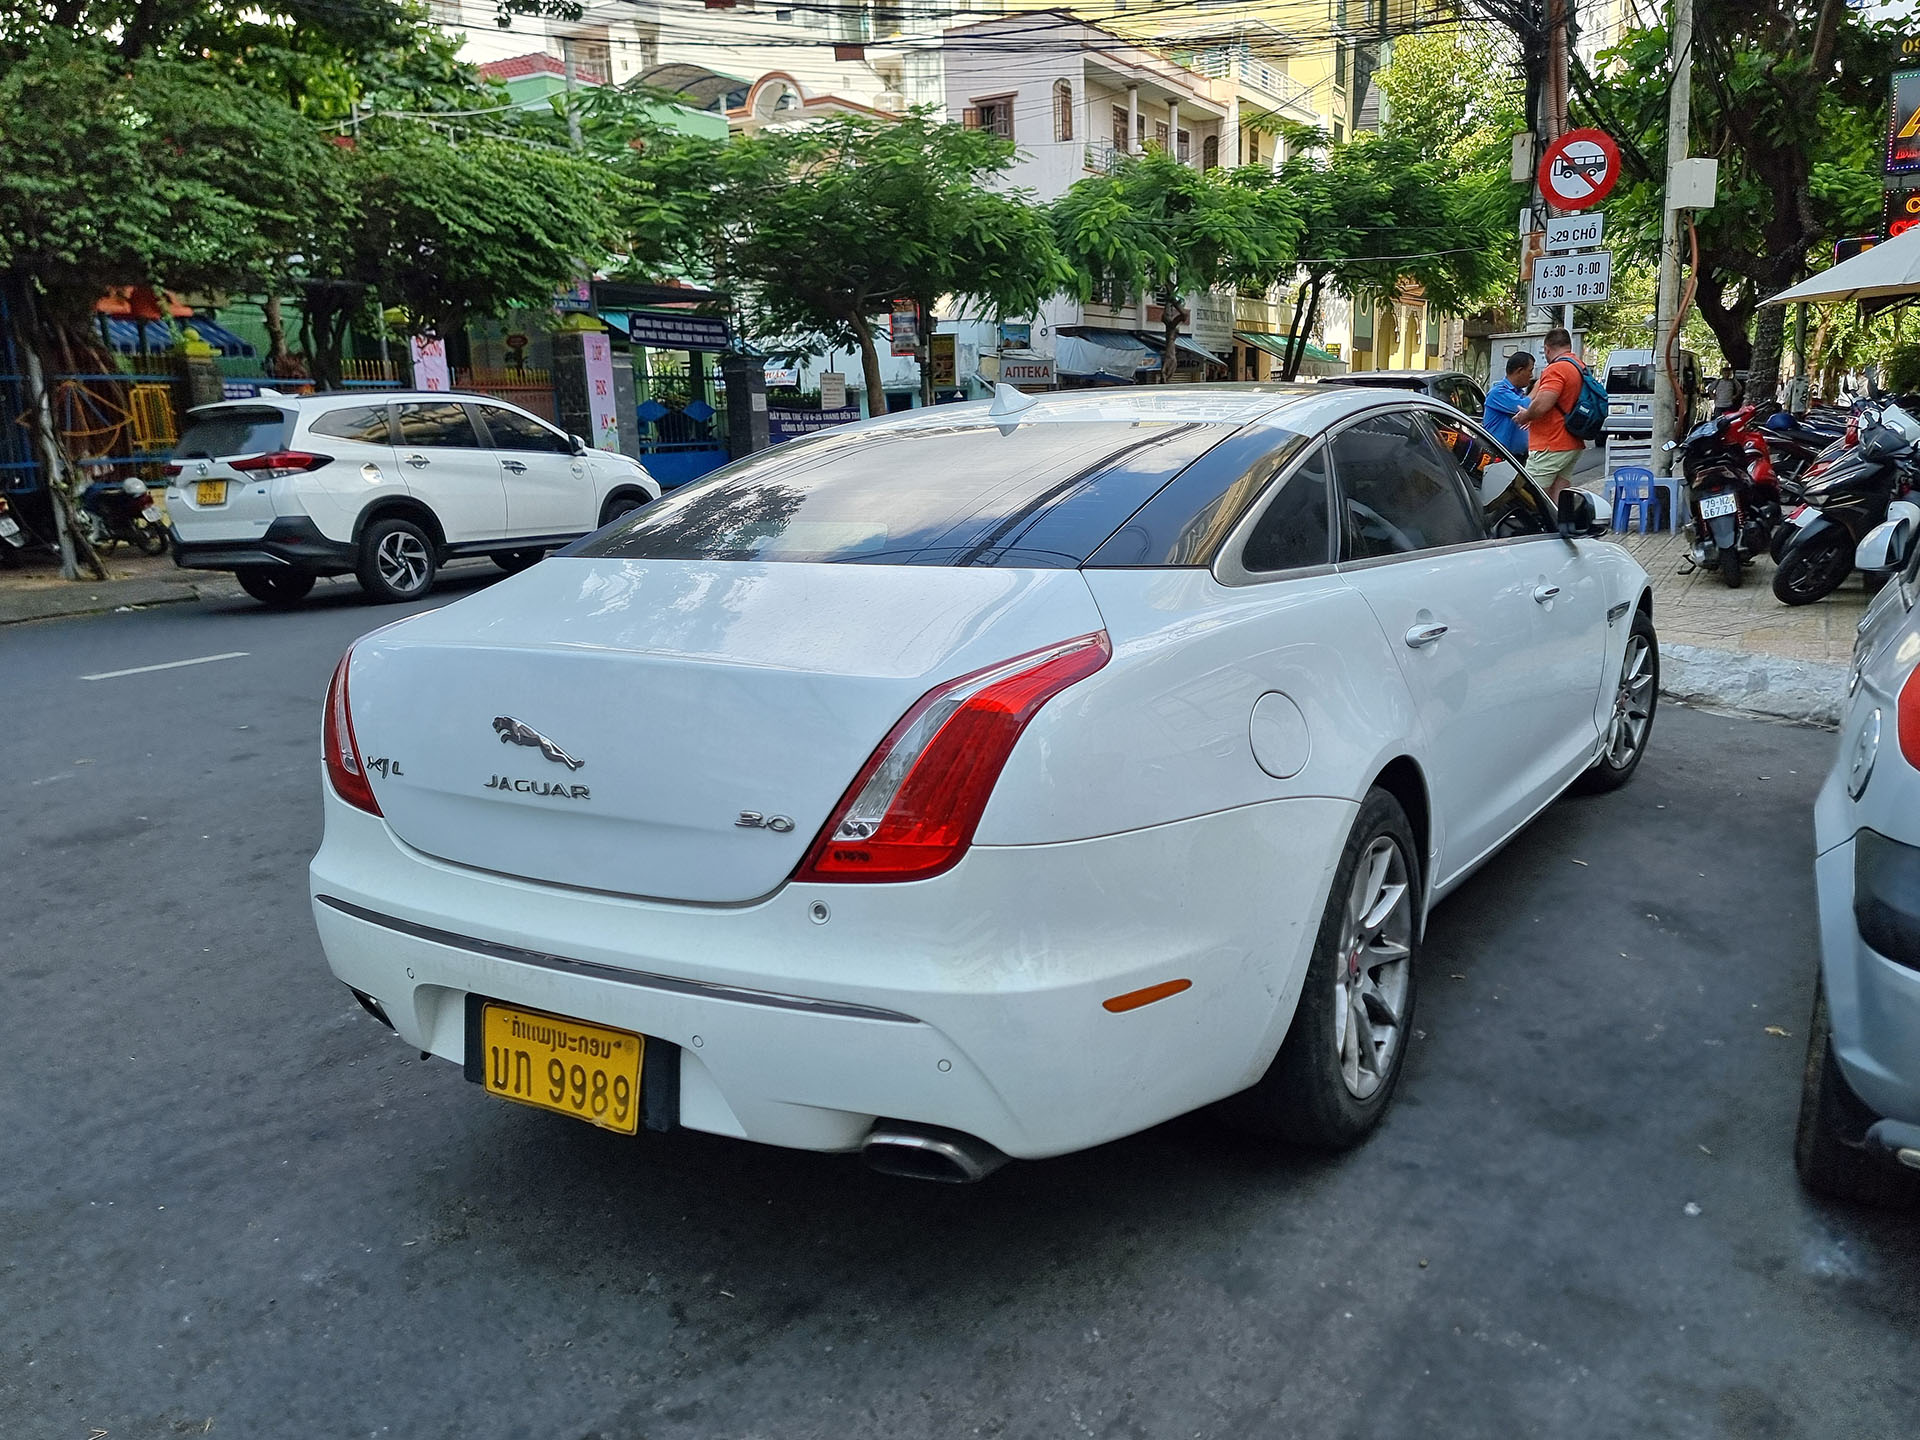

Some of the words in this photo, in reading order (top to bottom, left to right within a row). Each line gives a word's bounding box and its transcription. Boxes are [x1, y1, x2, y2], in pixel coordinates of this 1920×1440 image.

[1549, 230, 1569, 244] >29
[1572, 222, 1597, 241] CHỖ
[1543, 265, 1566, 279] 6:30
[1577, 262, 1600, 275] 8:00
[1537, 285, 1564, 299] 16:30
[1576, 282, 1605, 296] 18:30
[1005, 365, 1050, 378] АПТЕКА
[1704, 504, 1734, 518] 667.21
[483, 773, 592, 800] JAGUAR
[547, 1057, 631, 1123] 9989
